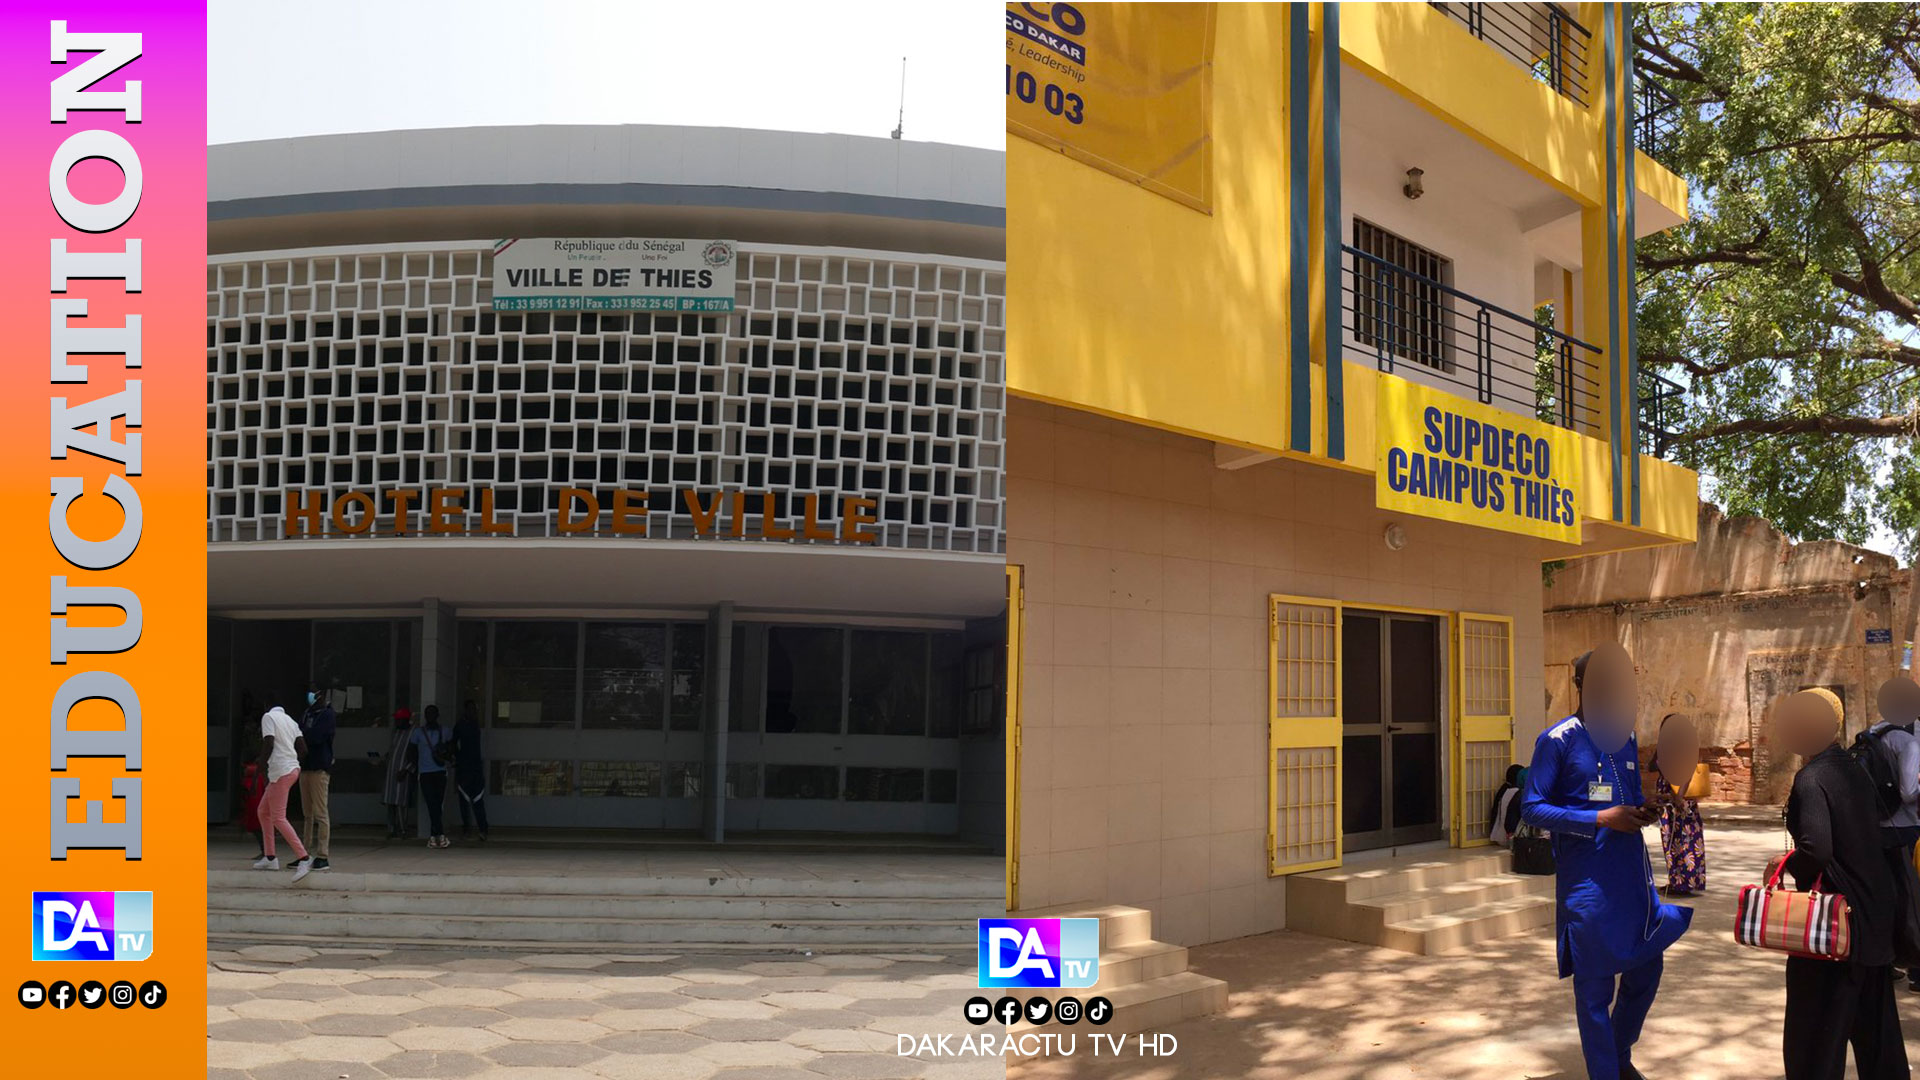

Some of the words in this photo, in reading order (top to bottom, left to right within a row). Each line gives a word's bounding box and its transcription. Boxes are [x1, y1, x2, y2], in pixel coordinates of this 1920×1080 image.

[1006, 2, 1085, 36] CO
[1027, 26, 1081, 60] DAKAR
[1018, 43, 1086, 83] Leadership
[1044, 83, 1085, 125] 03
[554, 239, 615, 253] République
[643, 239, 685, 254] Sénégal
[640, 268, 713, 289] THIES
[557, 298, 568, 309] 12
[569, 298, 581, 309] 91
[586, 298, 603, 309] Fax
[630, 298, 648, 309] 952
[649, 298, 661, 309] 25
[662, 299, 674, 309] 45
[682, 299, 695, 310] BP
[1424, 406, 1550, 480] SUPDECO
[1387, 447, 1505, 513] CAMPUS
[1510, 477, 1575, 527] THIÈS
[285, 488, 514, 536] HOTEL
[557, 488, 649, 535] DE
[683, 489, 877, 543] VILLE
